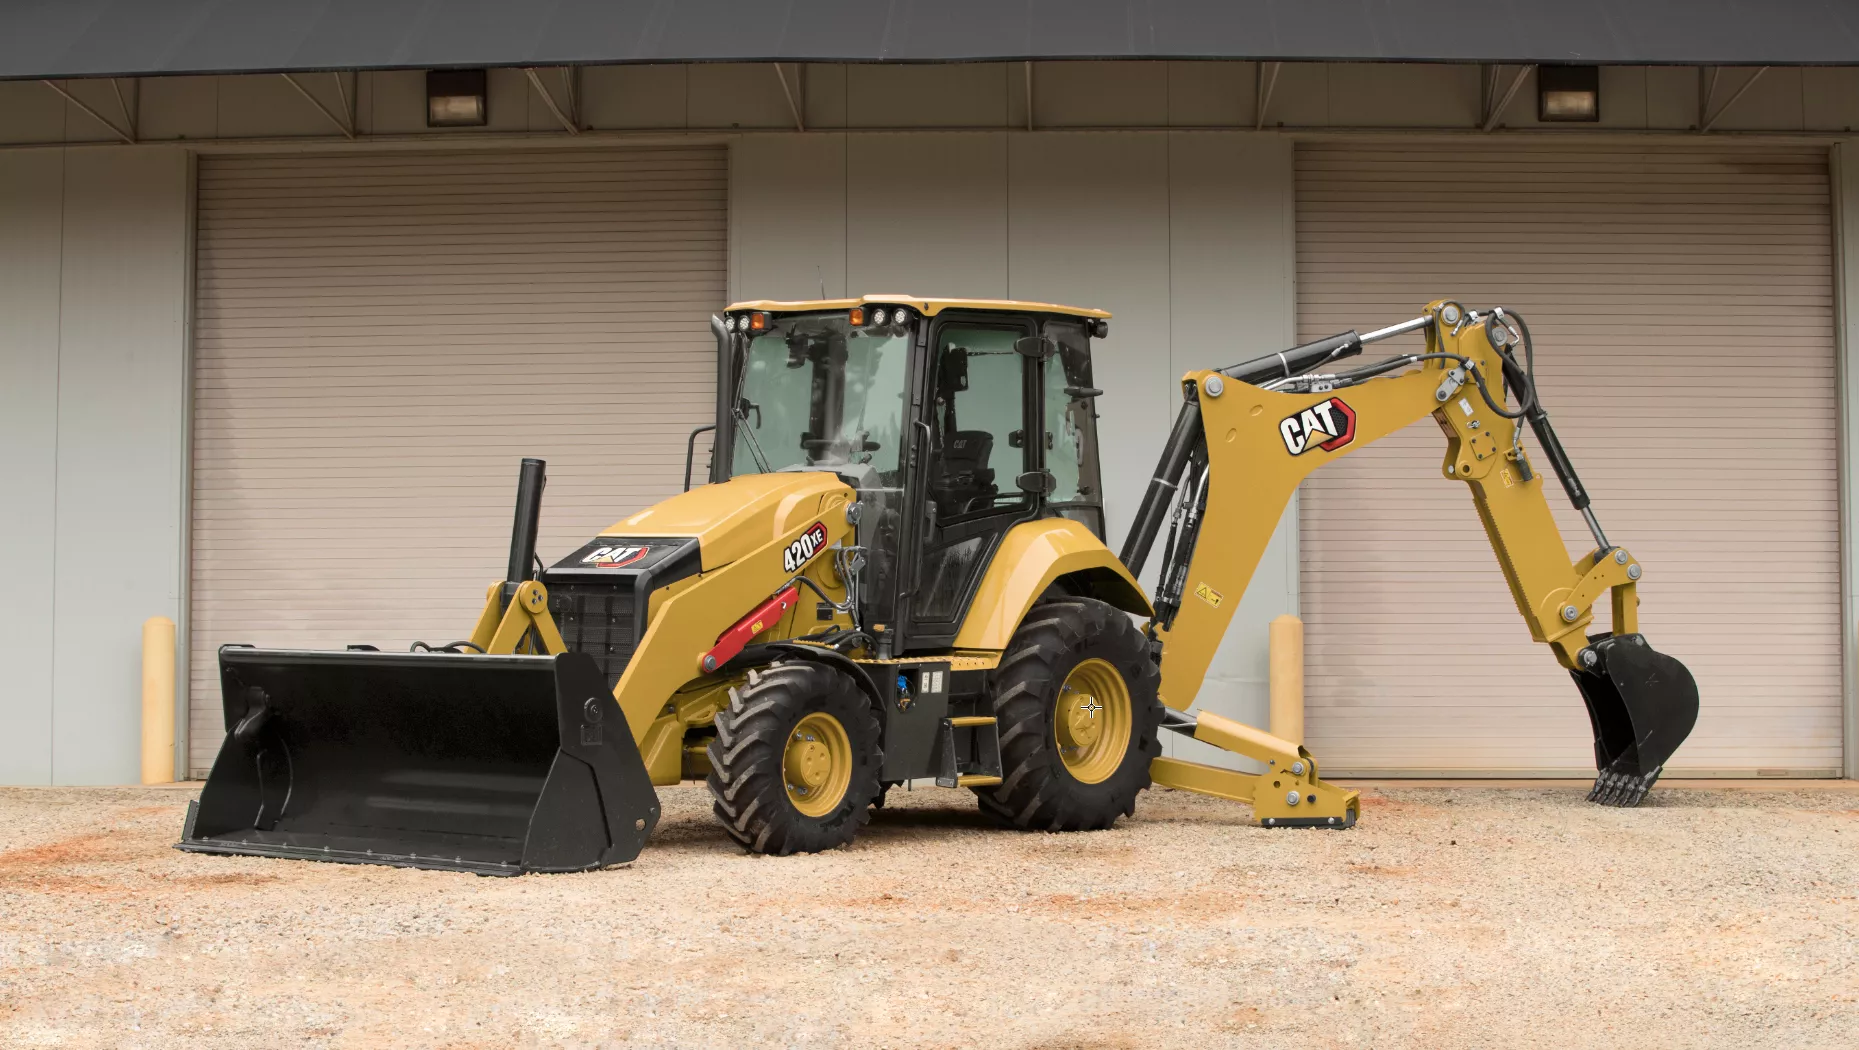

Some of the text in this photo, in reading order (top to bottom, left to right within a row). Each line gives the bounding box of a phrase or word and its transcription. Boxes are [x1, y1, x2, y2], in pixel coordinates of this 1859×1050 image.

[1280, 400, 1338, 455] CAT
[953, 440, 967, 448] CAT
[581, 547, 642, 563] CAT
